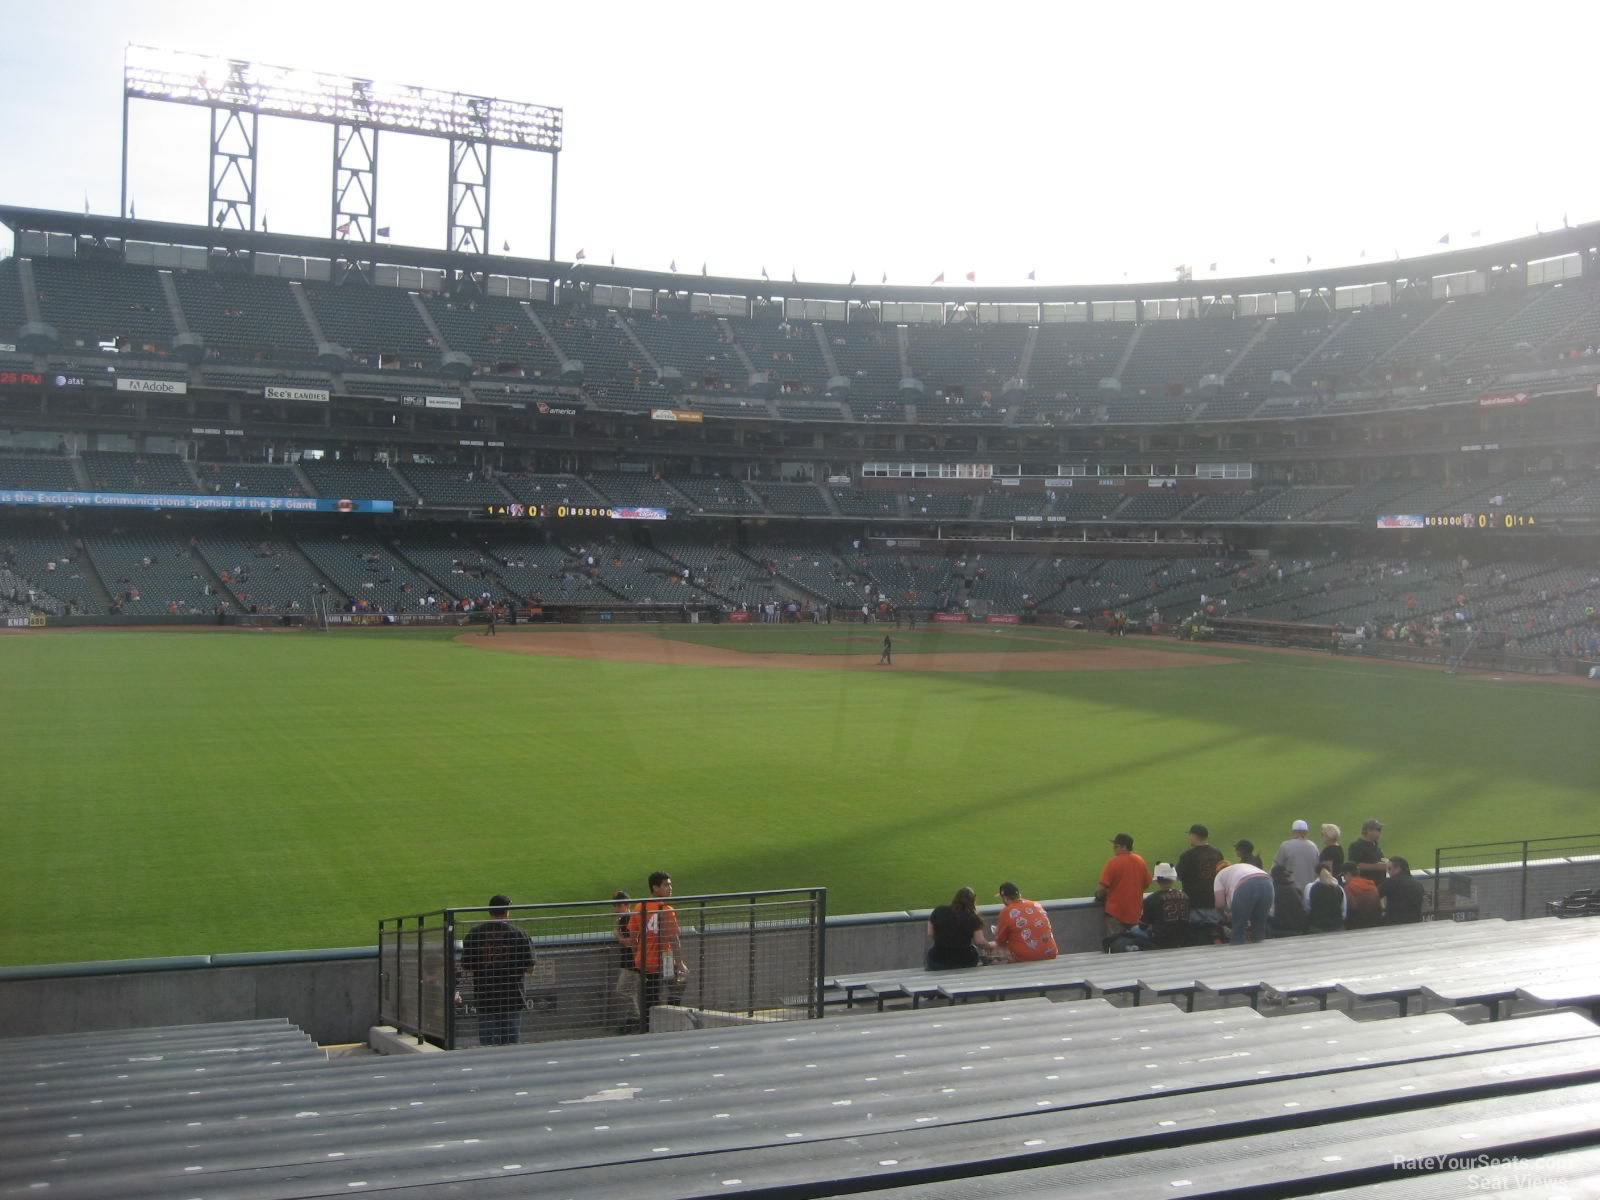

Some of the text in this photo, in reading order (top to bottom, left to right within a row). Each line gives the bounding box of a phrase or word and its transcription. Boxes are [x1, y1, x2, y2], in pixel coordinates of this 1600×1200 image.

[21, 373, 42, 384] PM
[142, 381, 175, 392] Adobe
[267, 387, 327, 400] See's CANDIES
[16, 493, 33, 502] the
[38, 494, 91, 504] Exclusive
[95, 495, 186, 506] Communications
[190, 498, 233, 509] Sponsor
[235, 499, 247, 508] of
[250, 499, 267, 508] the
[270, 500, 281, 508] SF
[285, 500, 317, 510] Giants
